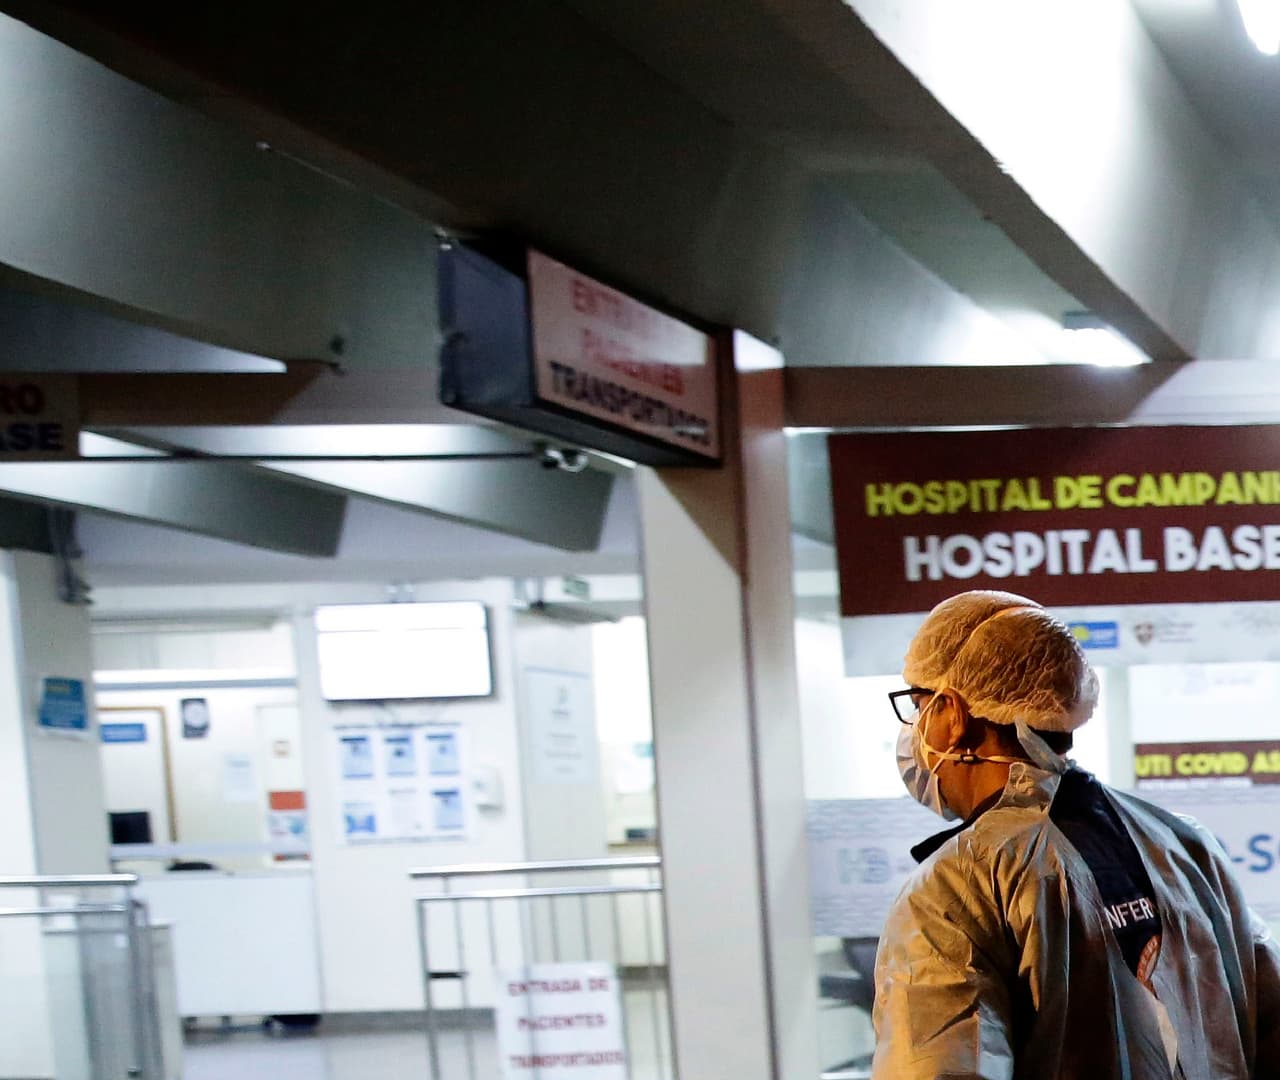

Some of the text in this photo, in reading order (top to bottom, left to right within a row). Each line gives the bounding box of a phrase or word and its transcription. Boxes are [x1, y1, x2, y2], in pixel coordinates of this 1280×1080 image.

[865, 478, 1050, 516] HOSPITAL
[1054, 475, 1104, 509] DE
[903, 528, 1158, 581] HOSPITAL
[1175, 752, 1248, 775] COVID
[508, 977, 609, 996] ENTRADA DE
